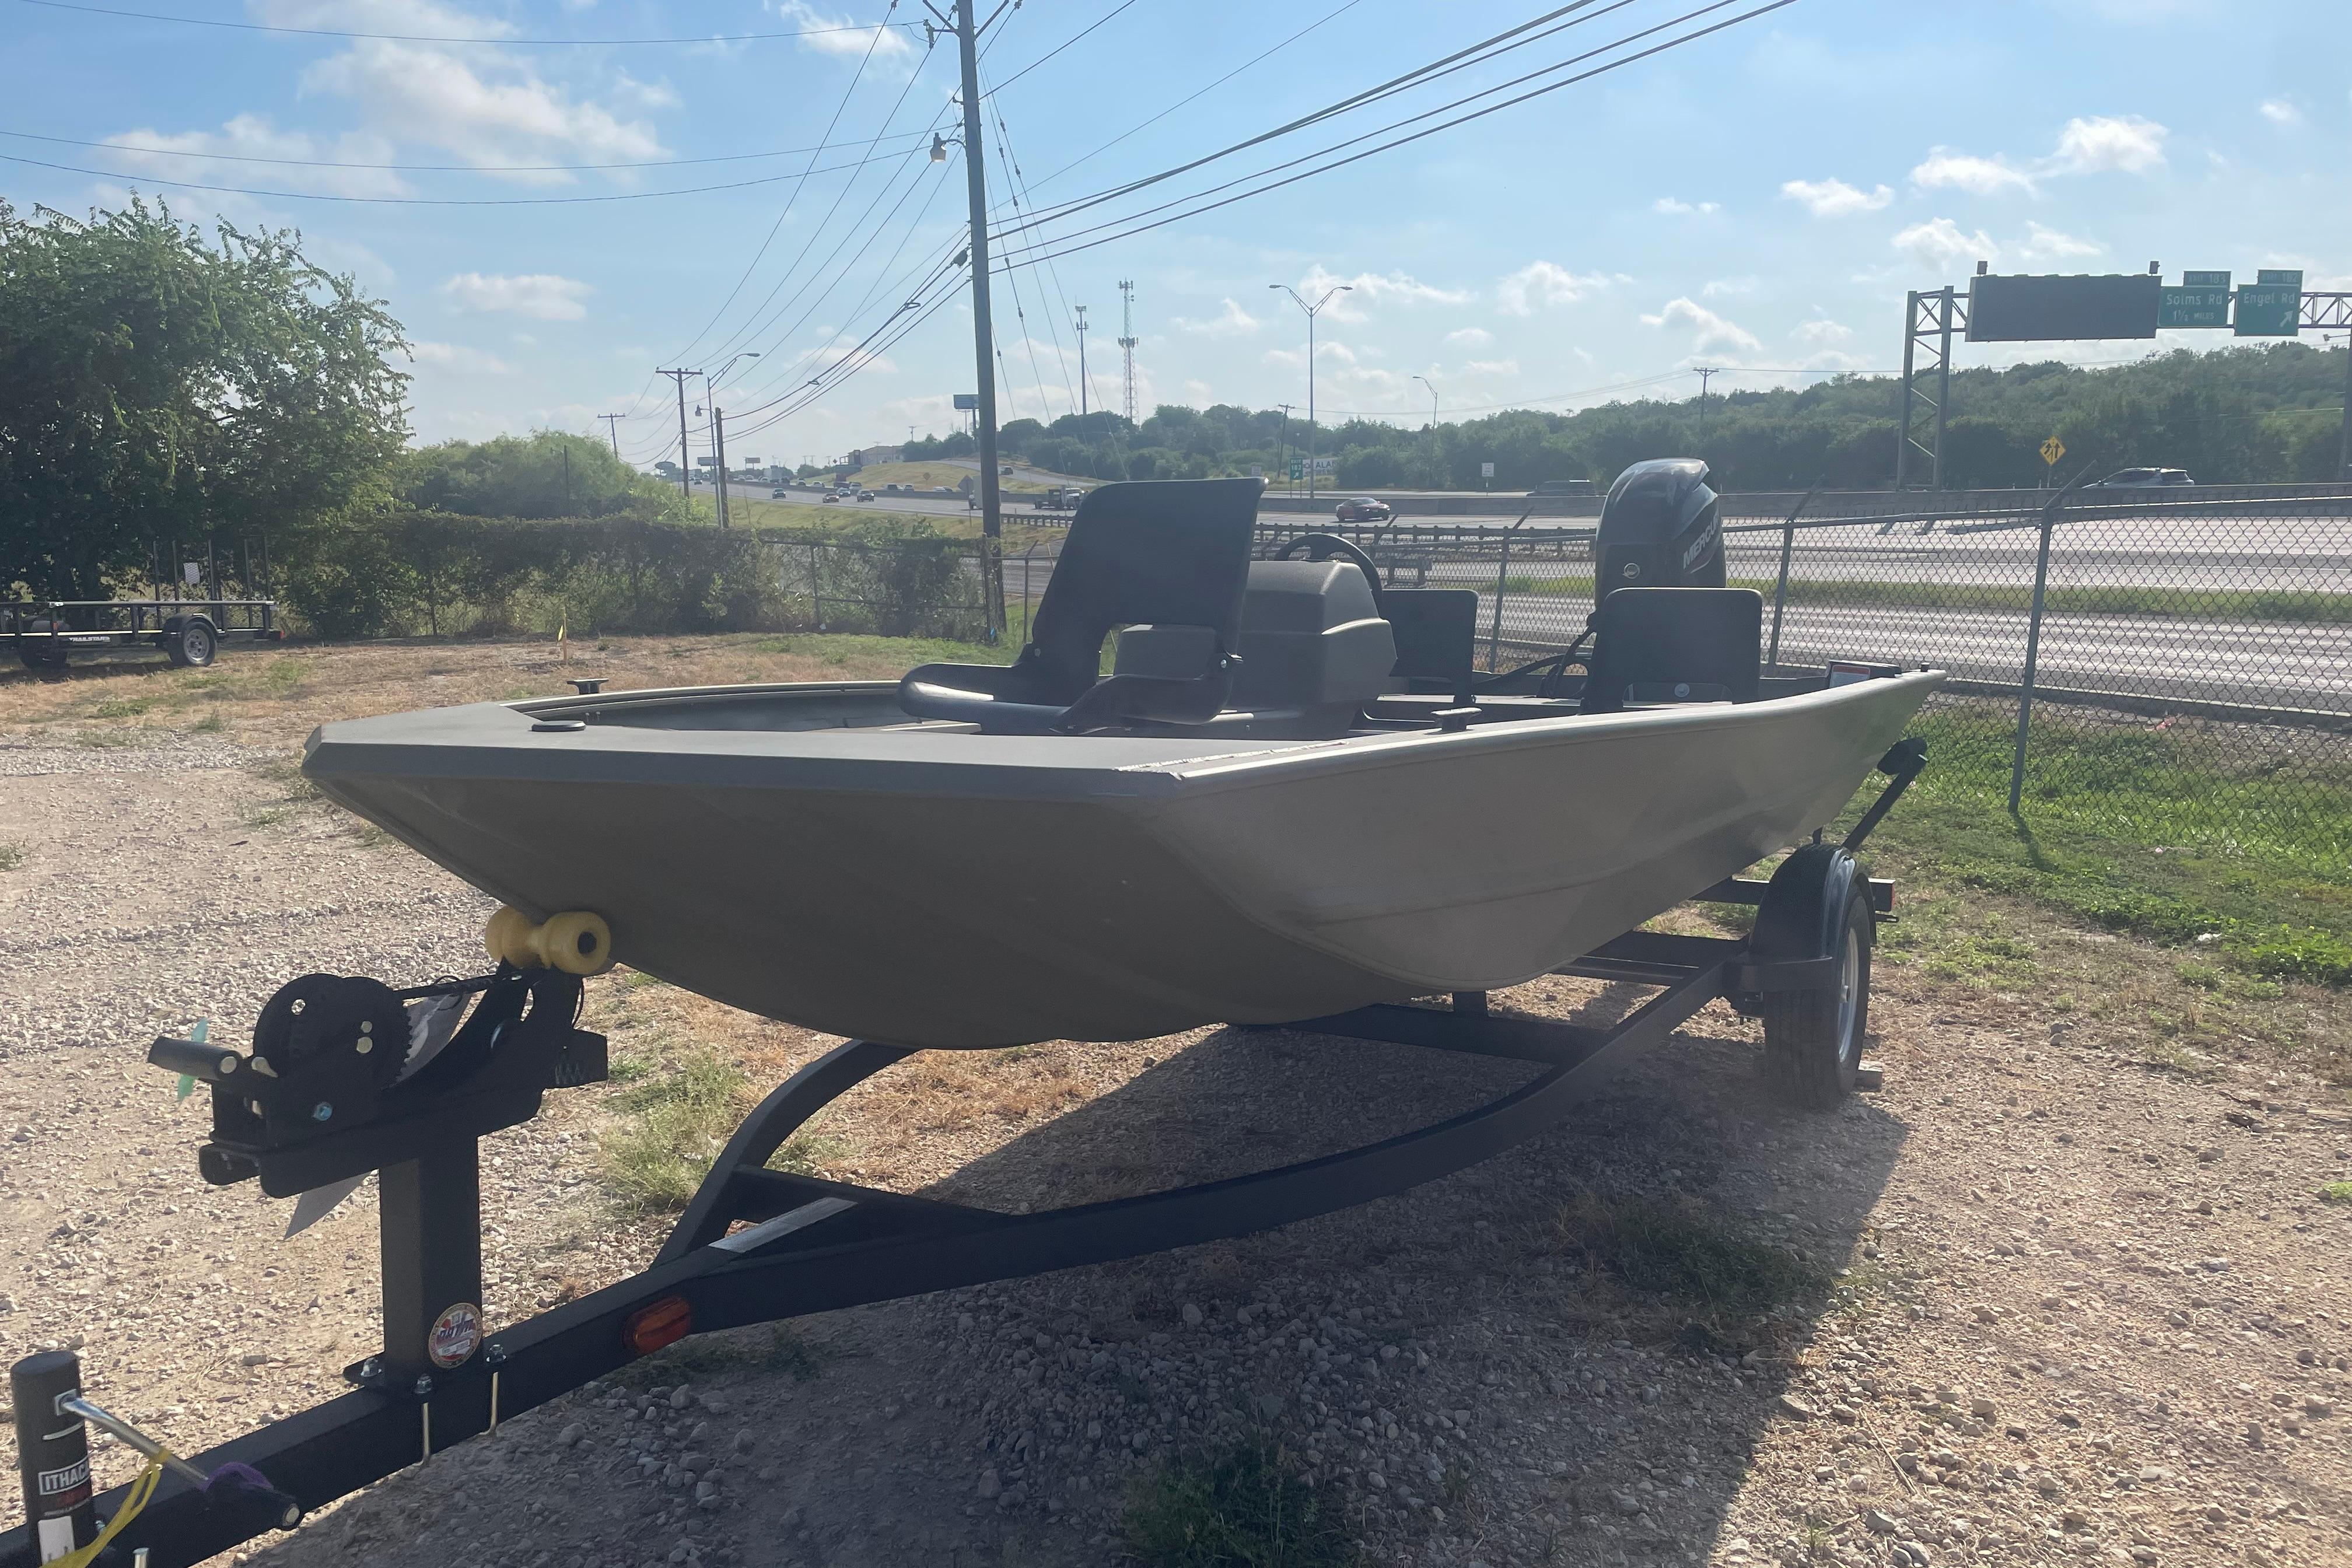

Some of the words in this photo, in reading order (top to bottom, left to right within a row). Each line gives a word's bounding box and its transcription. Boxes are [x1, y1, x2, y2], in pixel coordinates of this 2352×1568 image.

[2166, 293, 2202, 305] Solms
[2208, 293, 2222, 304] Rd
[2244, 292, 2274, 307] Engel
[2281, 293, 2295, 304] Rd
[1683, 511, 1720, 569] MERCUR
